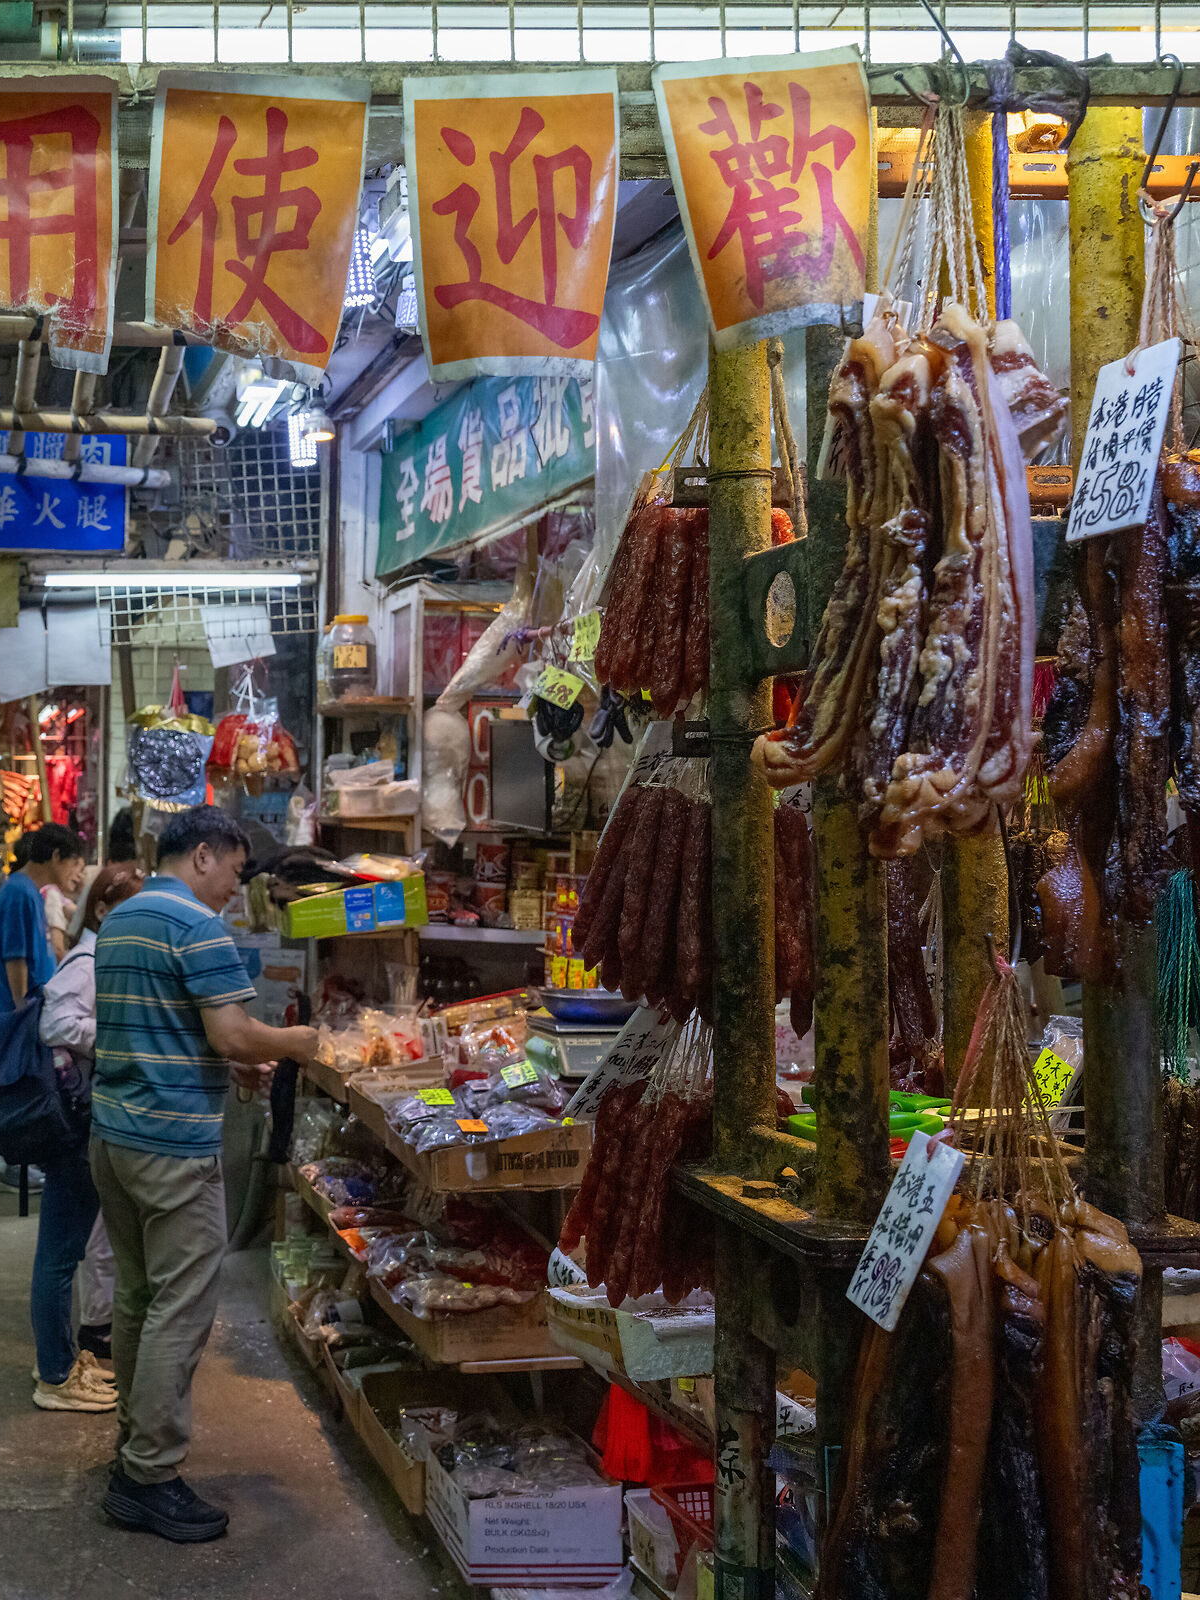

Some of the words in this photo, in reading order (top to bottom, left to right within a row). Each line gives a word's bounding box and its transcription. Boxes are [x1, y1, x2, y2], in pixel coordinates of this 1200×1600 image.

[698, 81, 865, 309] 歡
[167, 106, 329, 353] 使
[432, 106, 600, 348] 迎
[504, 1501, 542, 1510] INSHELL
[484, 1516, 500, 1525] Net
[484, 1529, 508, 1537] BULK
[484, 1545, 528, 1554] Production
